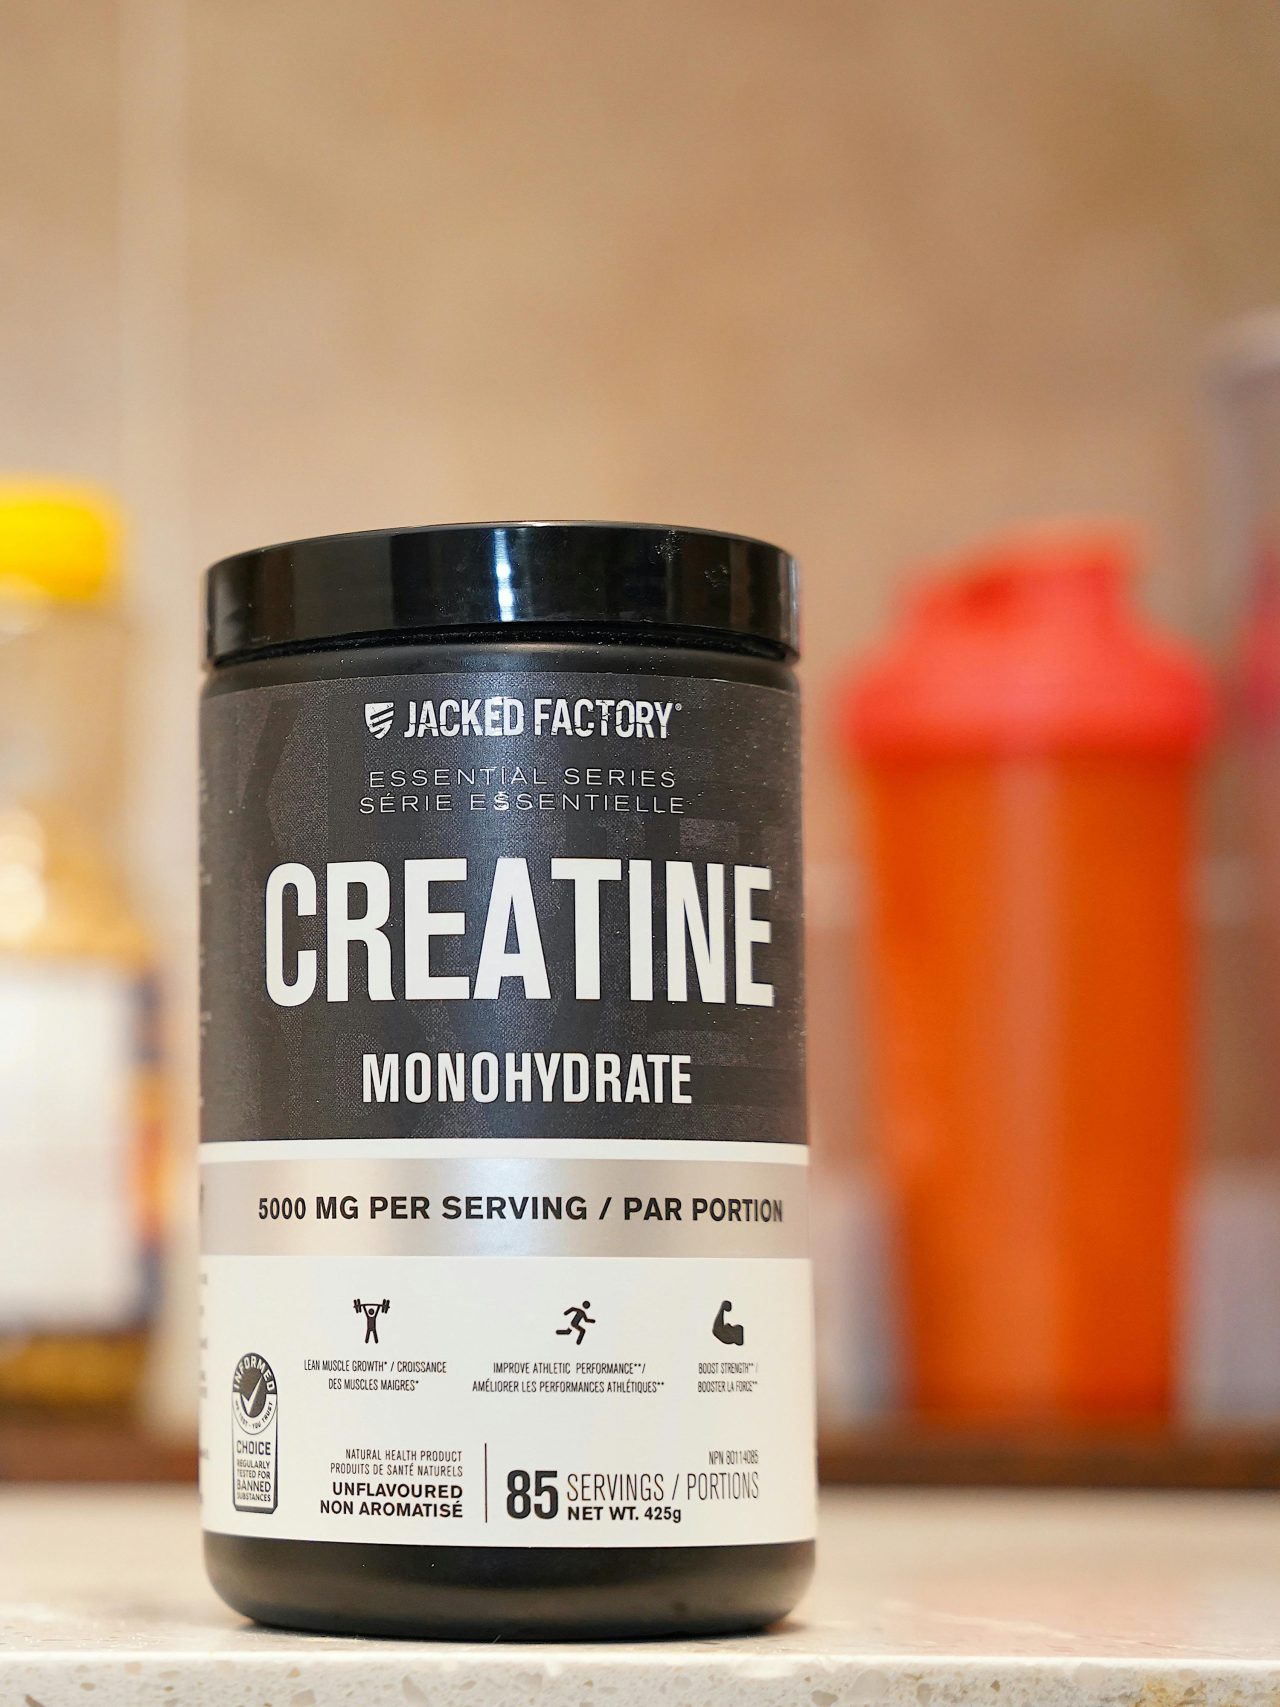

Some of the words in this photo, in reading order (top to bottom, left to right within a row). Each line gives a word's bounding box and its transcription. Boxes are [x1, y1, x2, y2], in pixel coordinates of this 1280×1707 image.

[404, 697, 524, 738] JACKED
[370, 767, 547, 788] ESSENTIAL
[564, 768, 676, 788] SERIES
[359, 793, 452, 814] SÉRIE
[470, 792, 685, 814] ESSENTIELLE
[265, 858, 775, 1007] CREATINE
[363, 1052, 693, 1104] MONOHYDRATE
[258, 1197, 306, 1220] 5000
[316, 1196, 359, 1220] MG
[370, 1196, 430, 1219] PER
[441, 1196, 587, 1220] SERVING
[599, 1196, 612, 1220] /
[624, 1197, 682, 1221] PAR
[692, 1198, 783, 1223] PORTION
[233, 1355, 275, 1391] INFORMED
[304, 1359, 320, 1371] LEAN
[322, 1360, 349, 1372] MUSCLE
[397, 1361, 447, 1373] CROISSANCE
[493, 1362, 530, 1374] IMPROVE
[533, 1362, 570, 1374] ATHLETIC
[699, 1362, 719, 1374] BOOST
[328, 1378, 342, 1390] DES
[344, 1379, 378, 1391] MUSCLES
[472, 1379, 519, 1393] AMÉLIORER
[522, 1381, 536, 1393] LES
[540, 1381, 604, 1393] PERFORMANCES
[698, 1381, 725, 1393] BOOSTER
[236, 1440, 271, 1455] CHOICE
[346, 1449, 381, 1460] NATURAL
[385, 1450, 417, 1461] HEALTH
[421, 1451, 462, 1462] PRODUCT
[708, 1451, 724, 1465] NPN
[237, 1459, 270, 1469] REGULARLY
[331, 1463, 370, 1475] PRODUITS
[373, 1464, 383, 1475] DE
[387, 1463, 414, 1476] SANTÉ
[417, 1465, 463, 1477] NATURELS
[237, 1469, 256, 1478] TESTED
[258, 1470, 270, 1479] FOR
[236, 1479, 271, 1492] BANNED
[333, 1482, 463, 1499] UNFLAVOURED
[236, 1492, 271, 1502] SUBSTANCES
[506, 1469, 559, 1520] 85
[567, 1473, 665, 1501] SERVINGS
[672, 1473, 680, 1501] /
[687, 1472, 759, 1501] PORTIONS
[320, 1500, 353, 1515] NON
[359, 1500, 463, 1518] AROMATISÉ
[567, 1507, 604, 1521] NET
[609, 1507, 639, 1521] WT.
[644, 1507, 682, 1523] 425g
